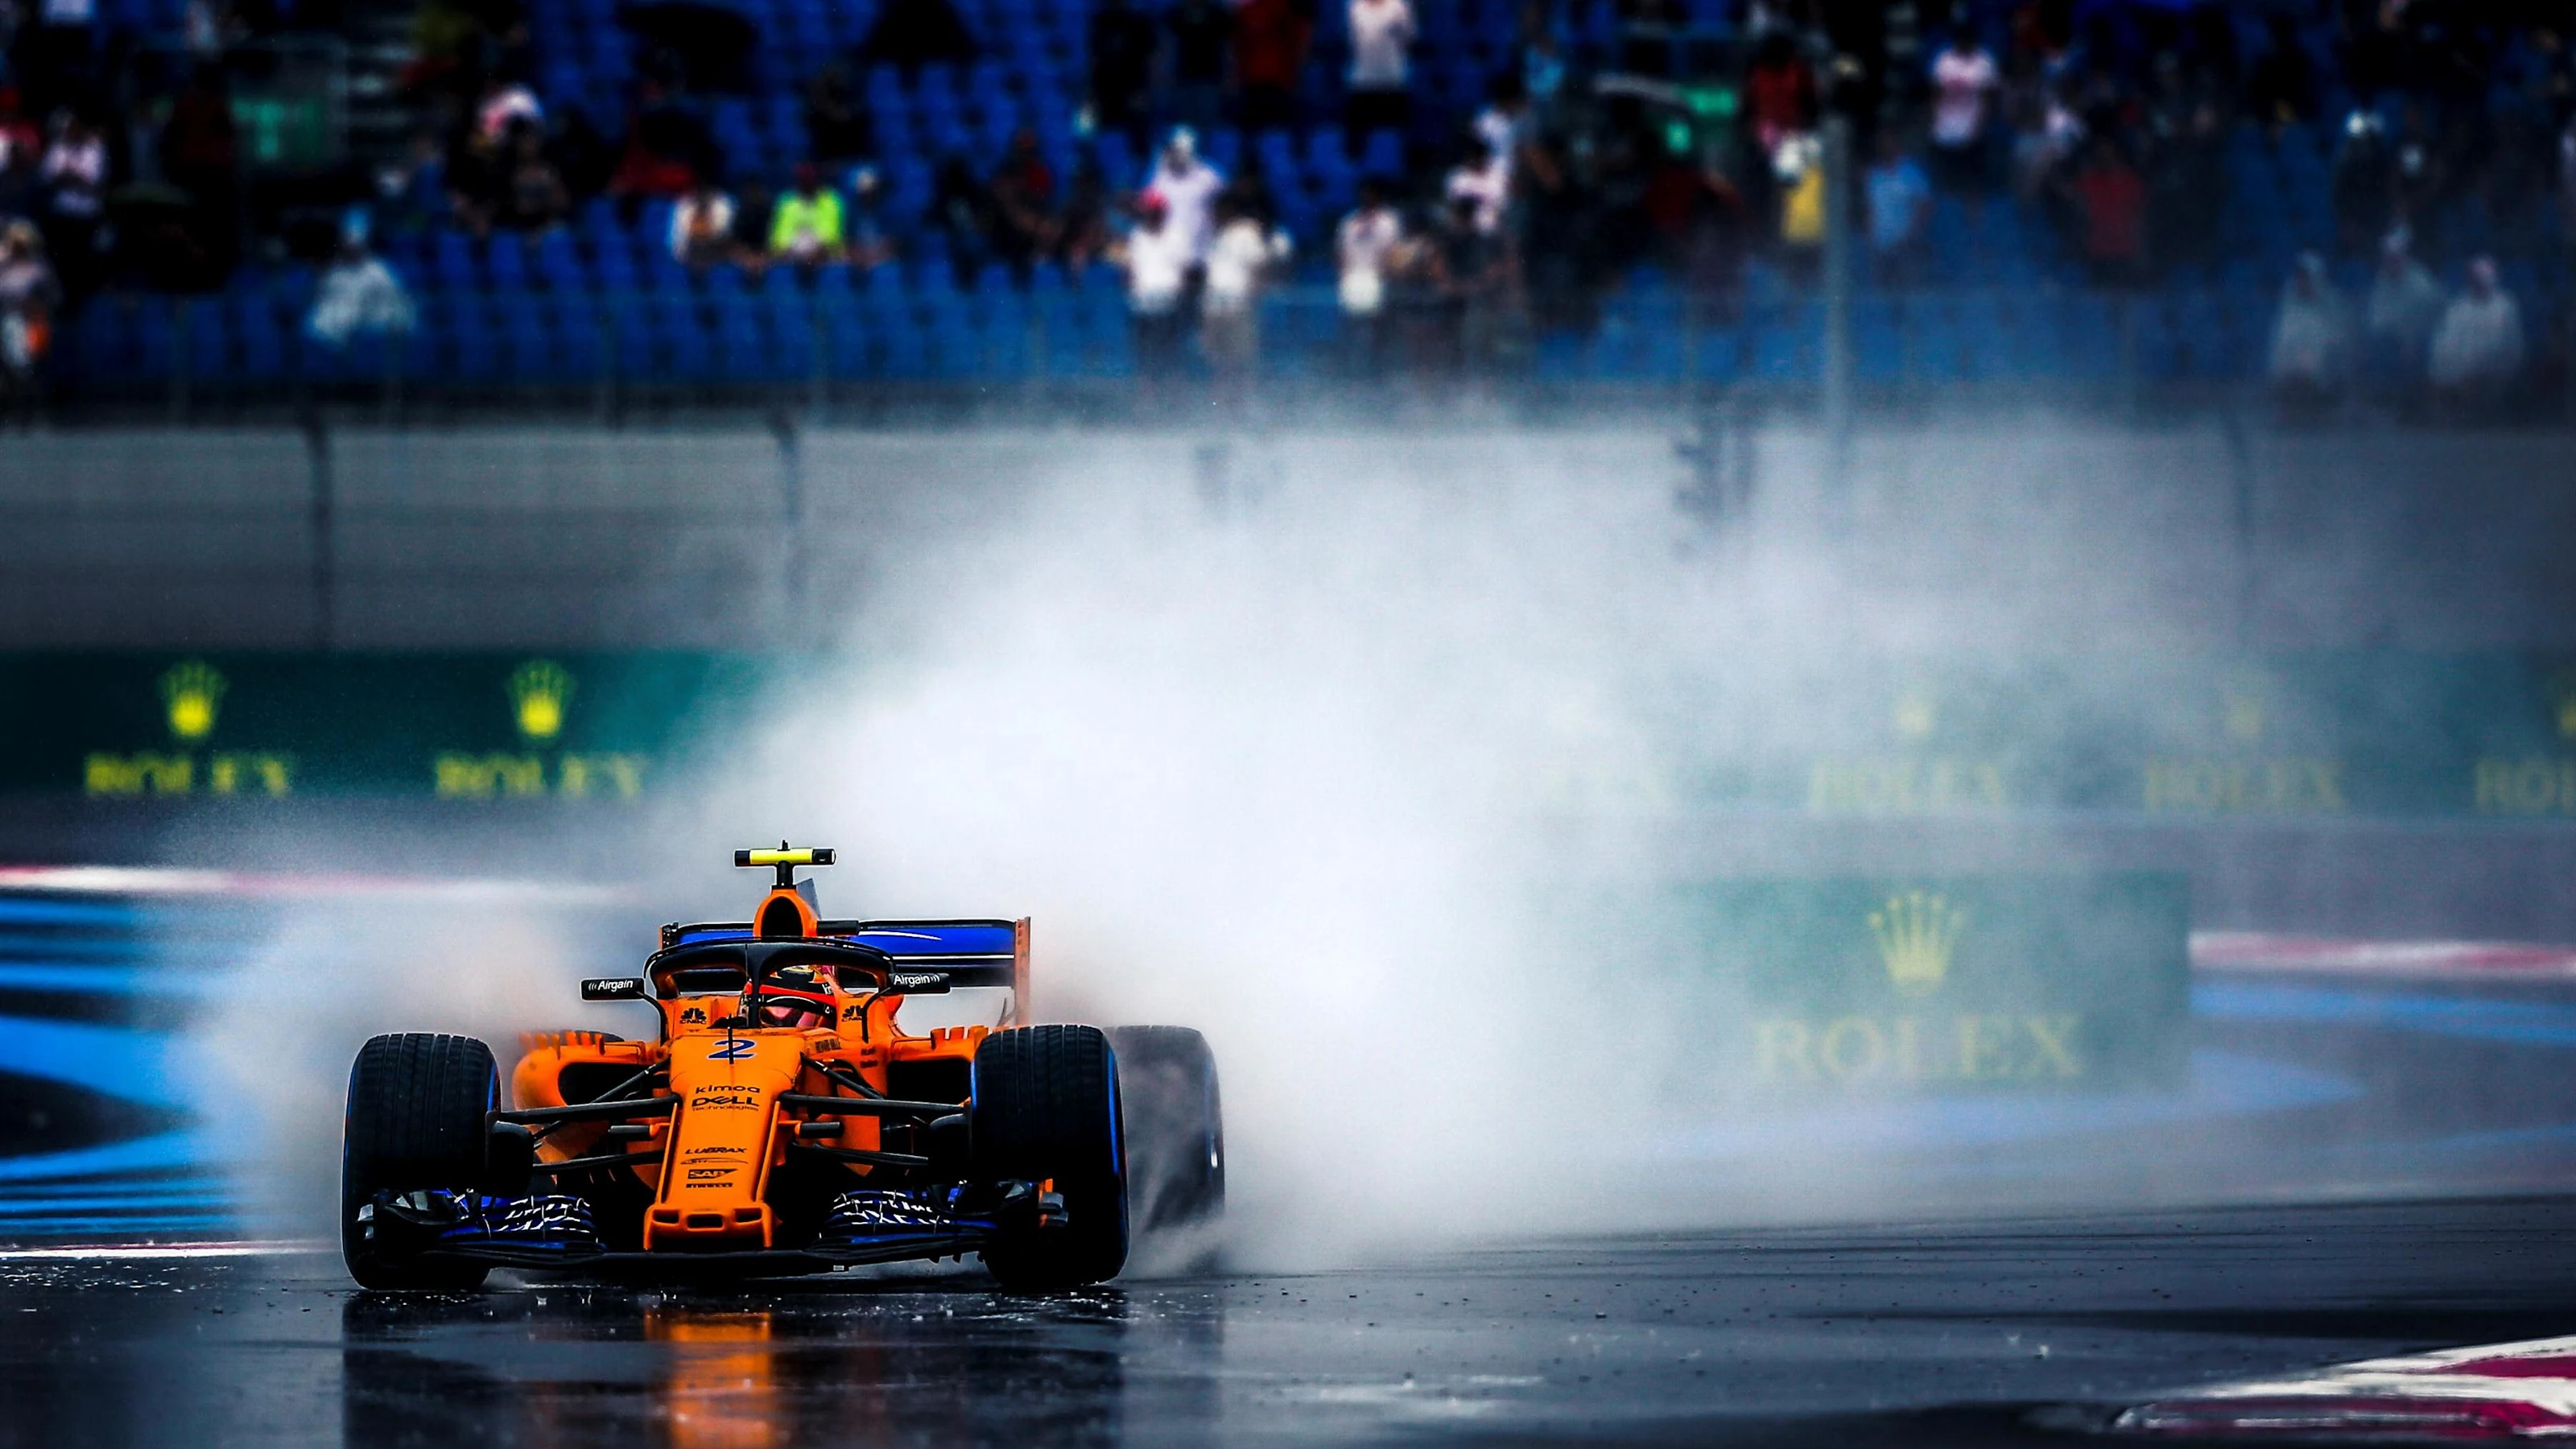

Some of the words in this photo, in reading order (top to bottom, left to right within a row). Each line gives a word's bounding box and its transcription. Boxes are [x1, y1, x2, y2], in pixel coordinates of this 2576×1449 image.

[894, 973, 931, 986] Airgain
[597, 980, 634, 993] Airgain
[707, 1038, 757, 1059] 2
[1755, 1013, 2083, 1080] ROLEX
[695, 1084, 761, 1094] kimoa
[691, 1096, 760, 1107] DELL
[688, 1170, 728, 1179] SAP
